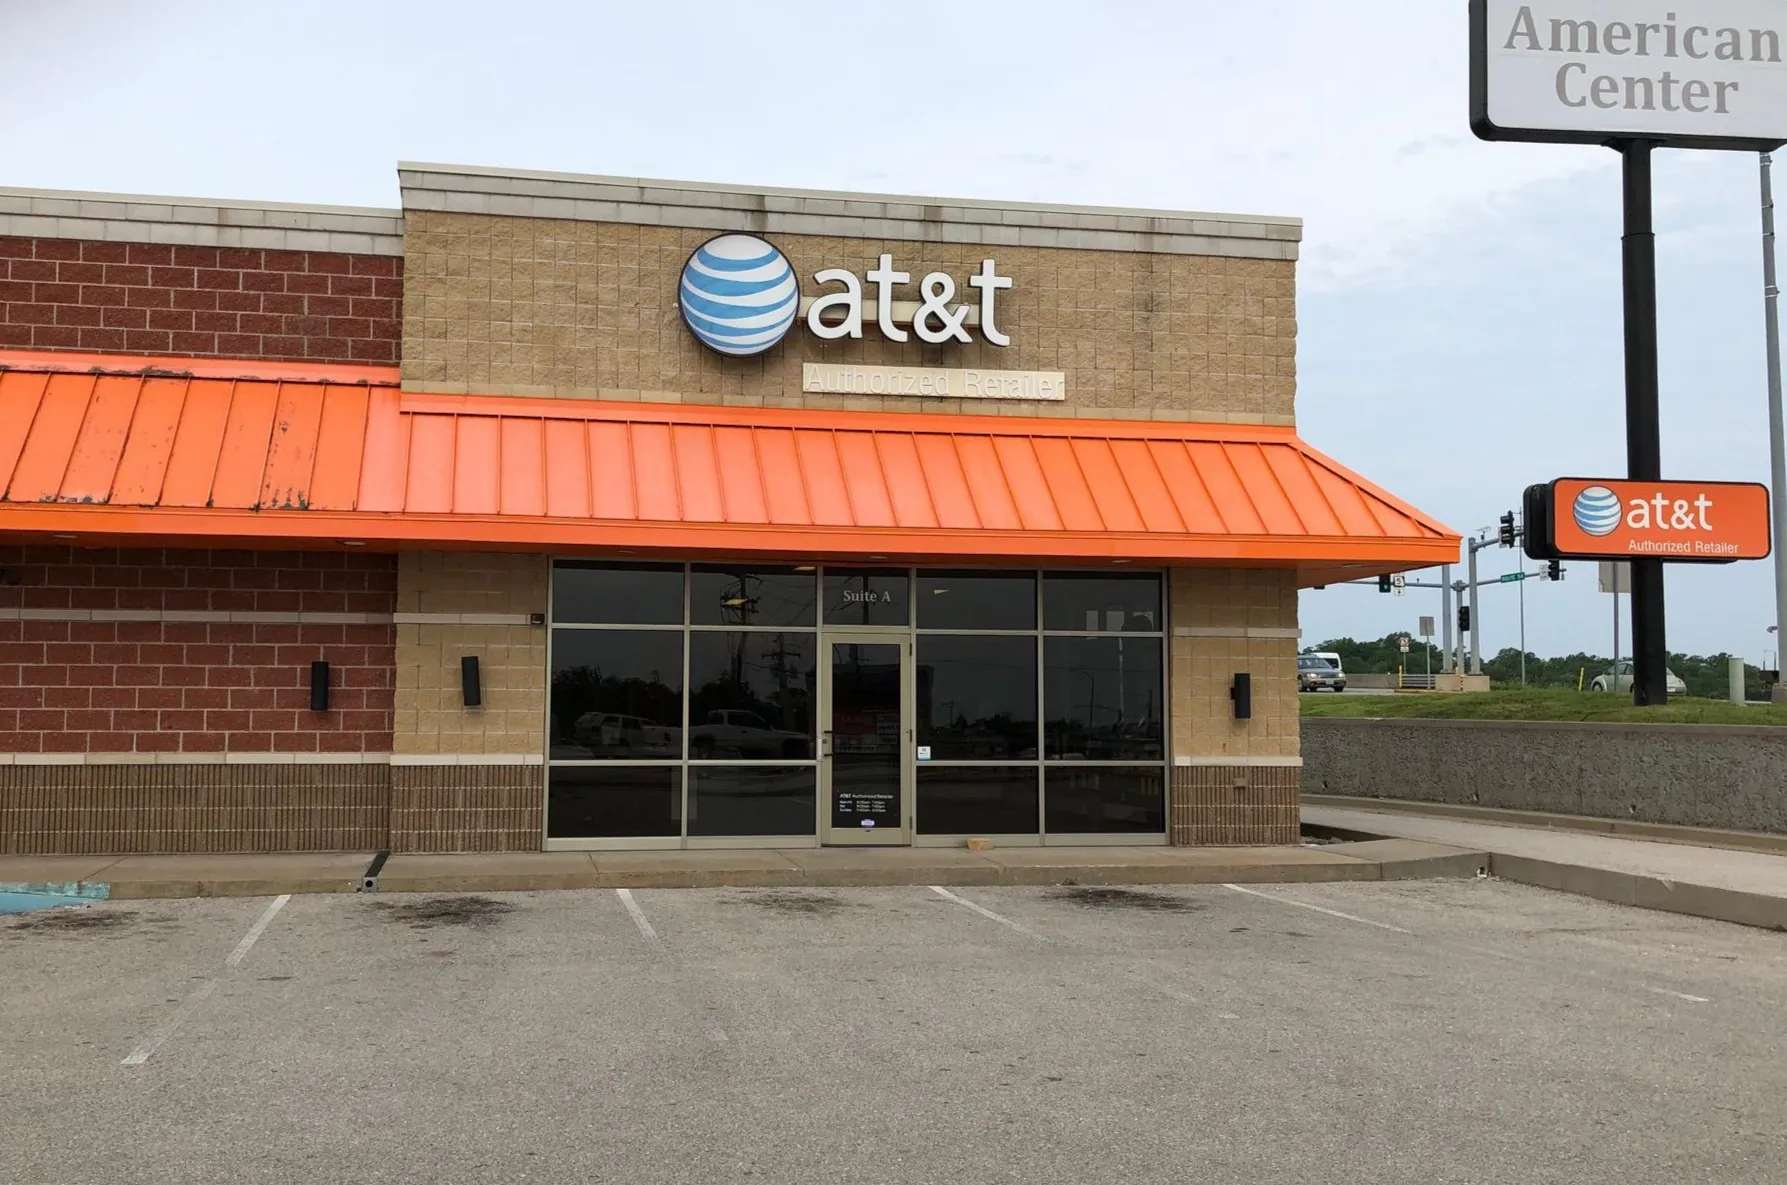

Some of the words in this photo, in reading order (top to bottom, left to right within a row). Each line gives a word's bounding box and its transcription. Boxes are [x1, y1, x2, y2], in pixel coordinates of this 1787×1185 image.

[1503, 5, 1782, 62] American
[1555, 62, 1739, 114] Center
[806, 253, 1013, 347] at&t
[806, 364, 949, 397] Authorized
[965, 371, 1065, 401] Retailer
[1626, 492, 1713, 531] at&t
[1628, 539, 1691, 553] Authorized
[1695, 541, 1739, 554] Retailer
[843, 590, 877, 602] Suite
[881, 590, 891, 602] A
